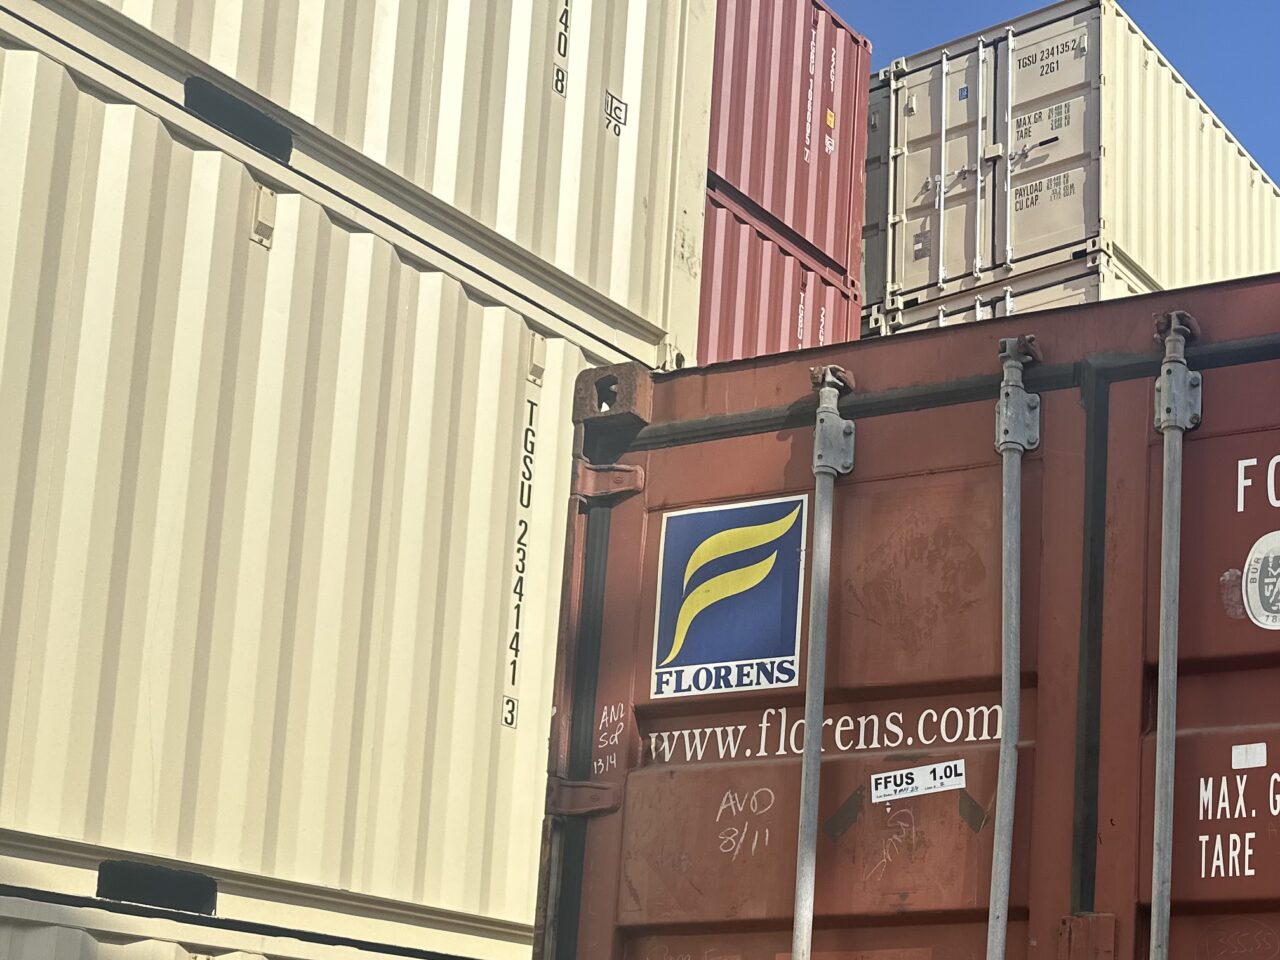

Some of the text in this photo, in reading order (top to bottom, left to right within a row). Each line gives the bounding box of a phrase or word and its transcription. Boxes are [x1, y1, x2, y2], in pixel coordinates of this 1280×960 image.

[555, 0, 569, 94] 40 8
[1017, 53, 1037, 69] TGSU
[1040, 41, 1070, 61] 234135
[1040, 60, 1059, 76] 22G1
[1016, 126, 1031, 141] TARE
[1015, 181, 1043, 200] PAYLOAD
[504, 399, 538, 726] TGSU 234141 3
[654, 659, 795, 695] FLORENS
[875, 764, 963, 791] FFUS 1.0L
[1199, 775, 1256, 820] MAX.
[1199, 832, 1256, 878] TARE
